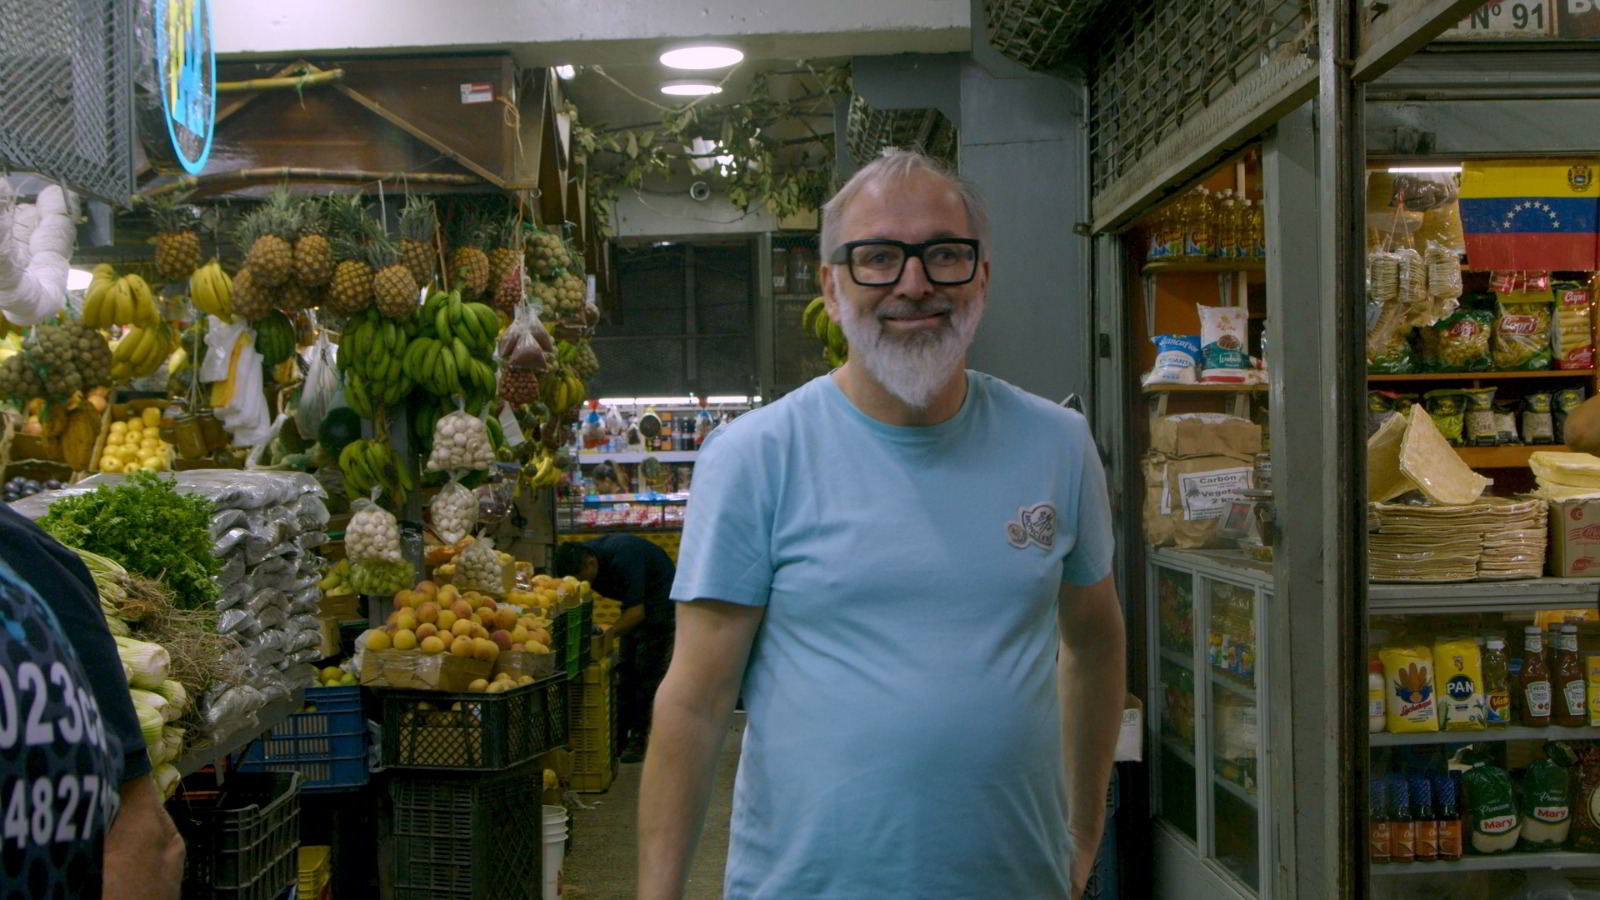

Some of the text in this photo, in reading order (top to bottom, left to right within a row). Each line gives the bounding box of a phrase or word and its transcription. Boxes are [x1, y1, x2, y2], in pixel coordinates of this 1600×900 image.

[1512, 3, 1543, 29] 91
[1447, 681, 1473, 694] PAN
[1537, 808, 1567, 818] Mary
[1484, 818, 1513, 831] Mary
